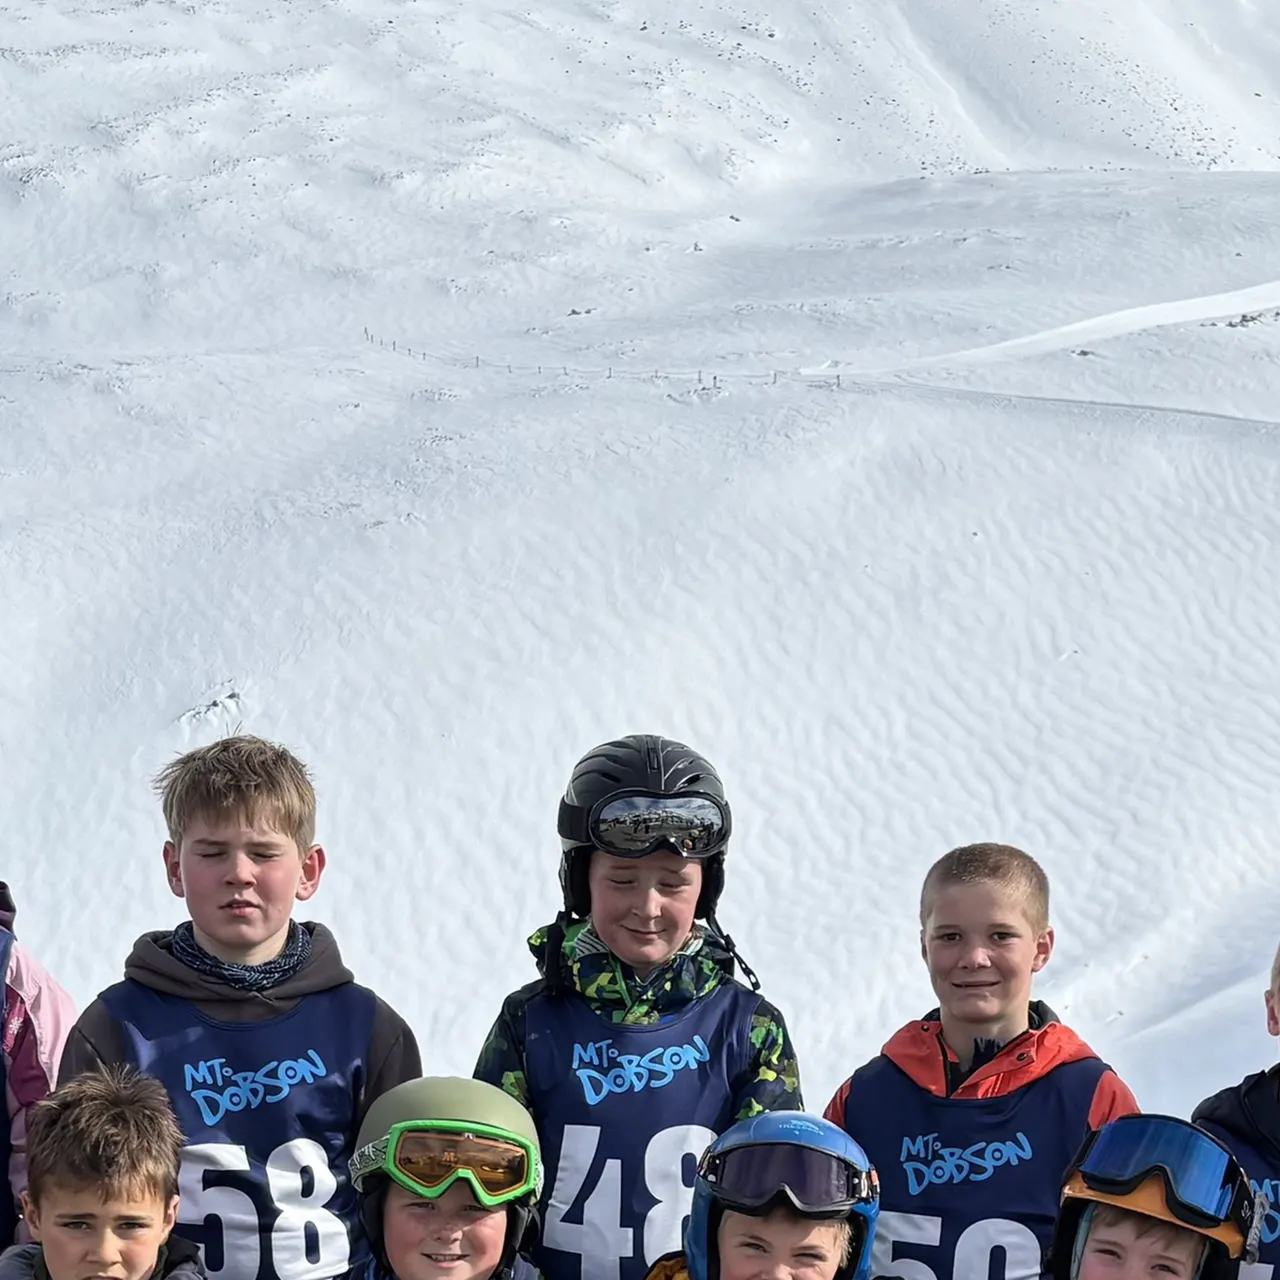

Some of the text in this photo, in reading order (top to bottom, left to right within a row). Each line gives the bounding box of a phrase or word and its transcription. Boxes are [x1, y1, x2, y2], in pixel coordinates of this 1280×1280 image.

[191, 1049, 327, 1126] DOBSON
[576, 1035, 710, 1106] DOBSON
[903, 1132, 1033, 1196] DOBSON
